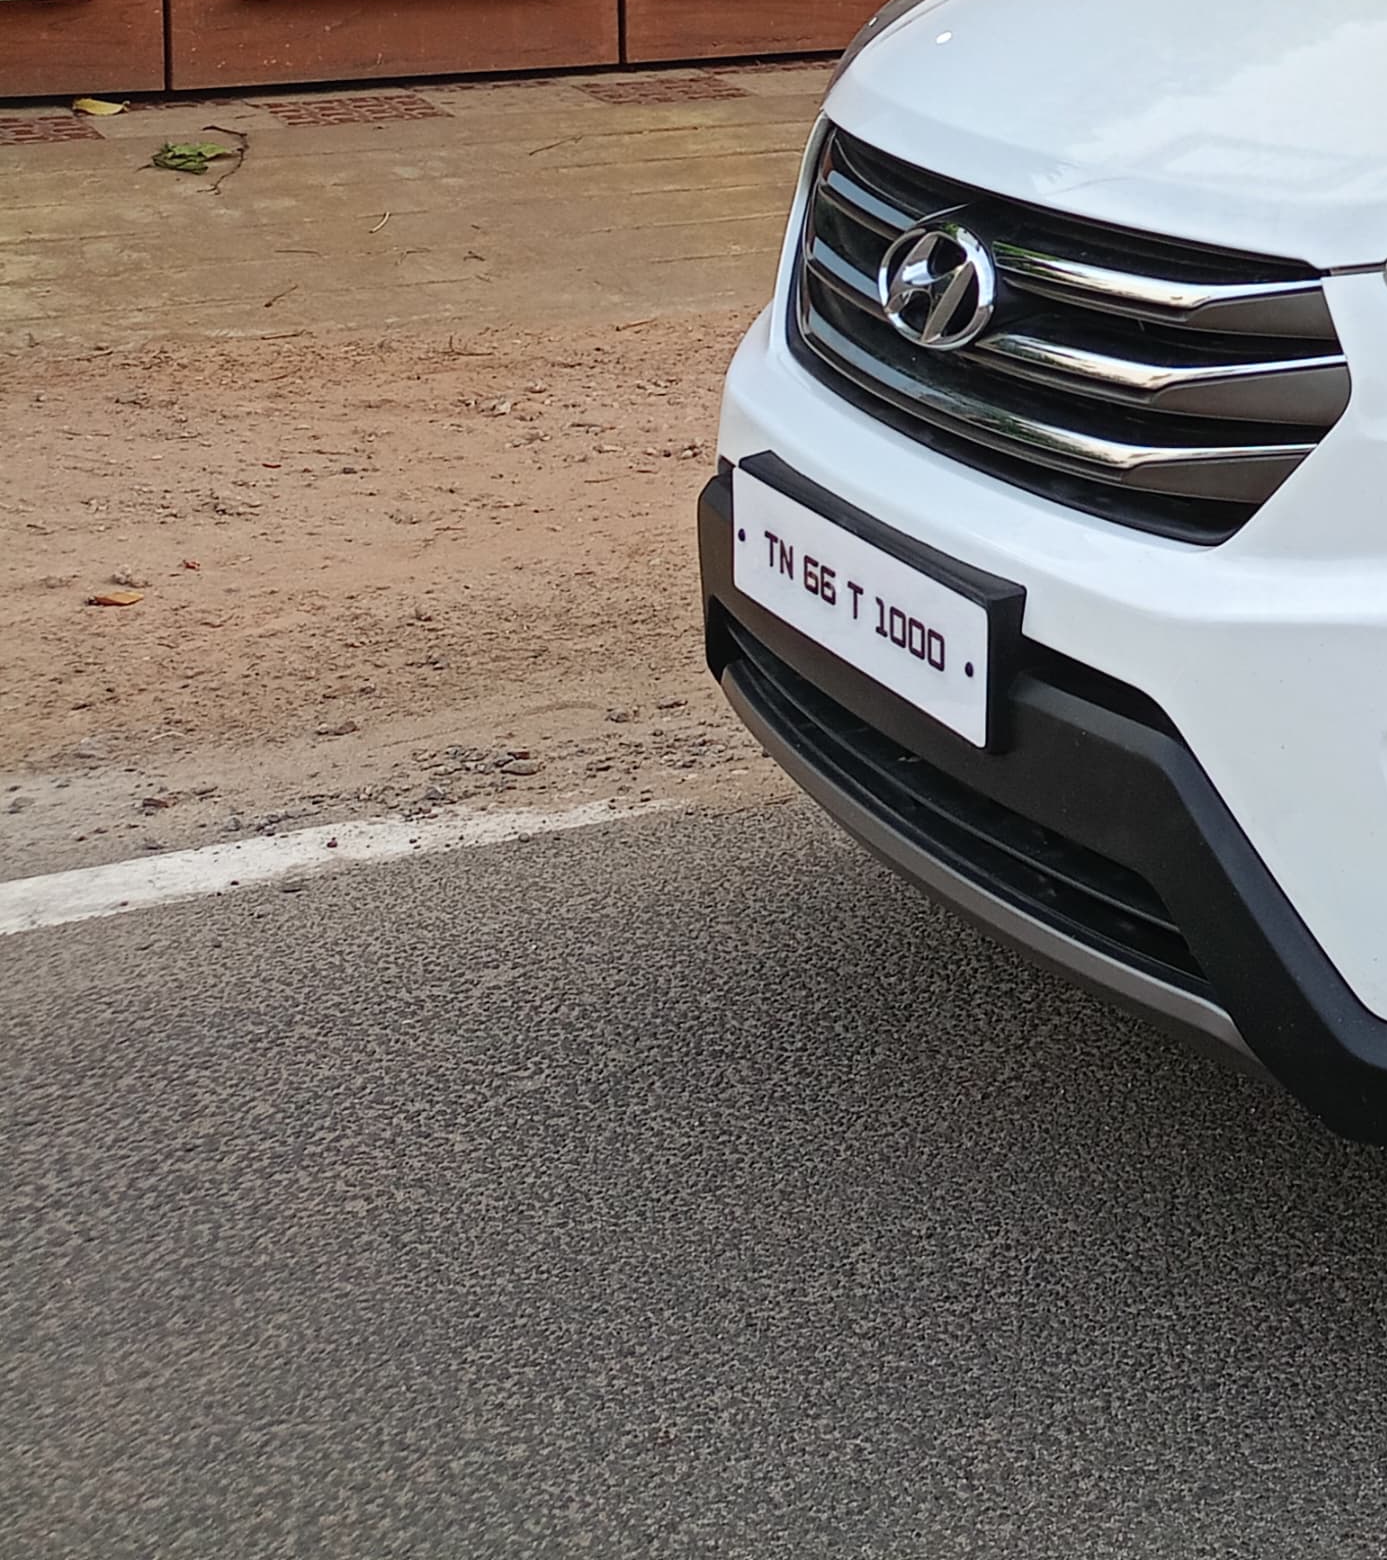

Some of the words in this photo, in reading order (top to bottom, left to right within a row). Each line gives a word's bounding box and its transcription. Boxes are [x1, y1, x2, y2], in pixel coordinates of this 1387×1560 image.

[764, 530, 794, 580] TN
[803, 554, 836, 606] 66
[847, 580, 864, 620] T
[875, 596, 945, 672] 1000
